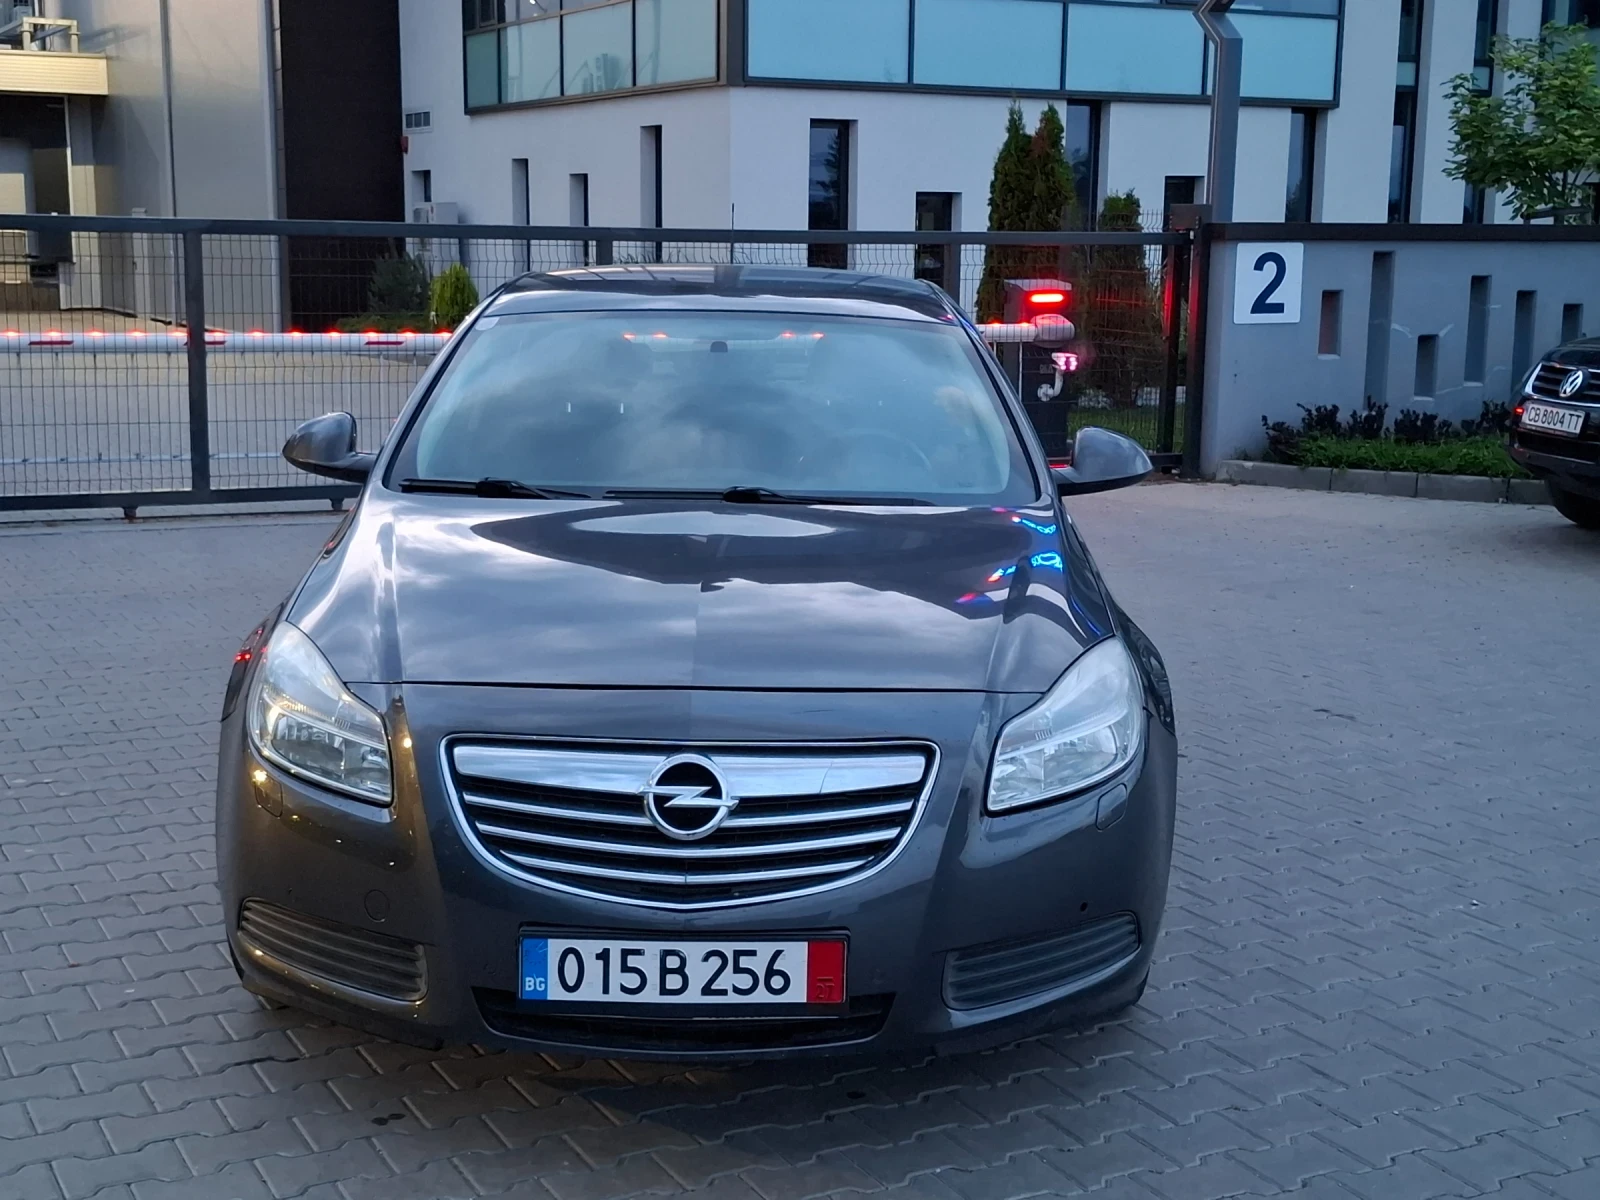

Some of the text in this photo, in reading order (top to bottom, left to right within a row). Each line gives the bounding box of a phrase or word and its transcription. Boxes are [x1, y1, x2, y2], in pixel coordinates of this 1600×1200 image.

[1250, 251, 1287, 315] 2
[1541, 408, 1565, 427] 8004
[525, 976, 546, 992] BG
